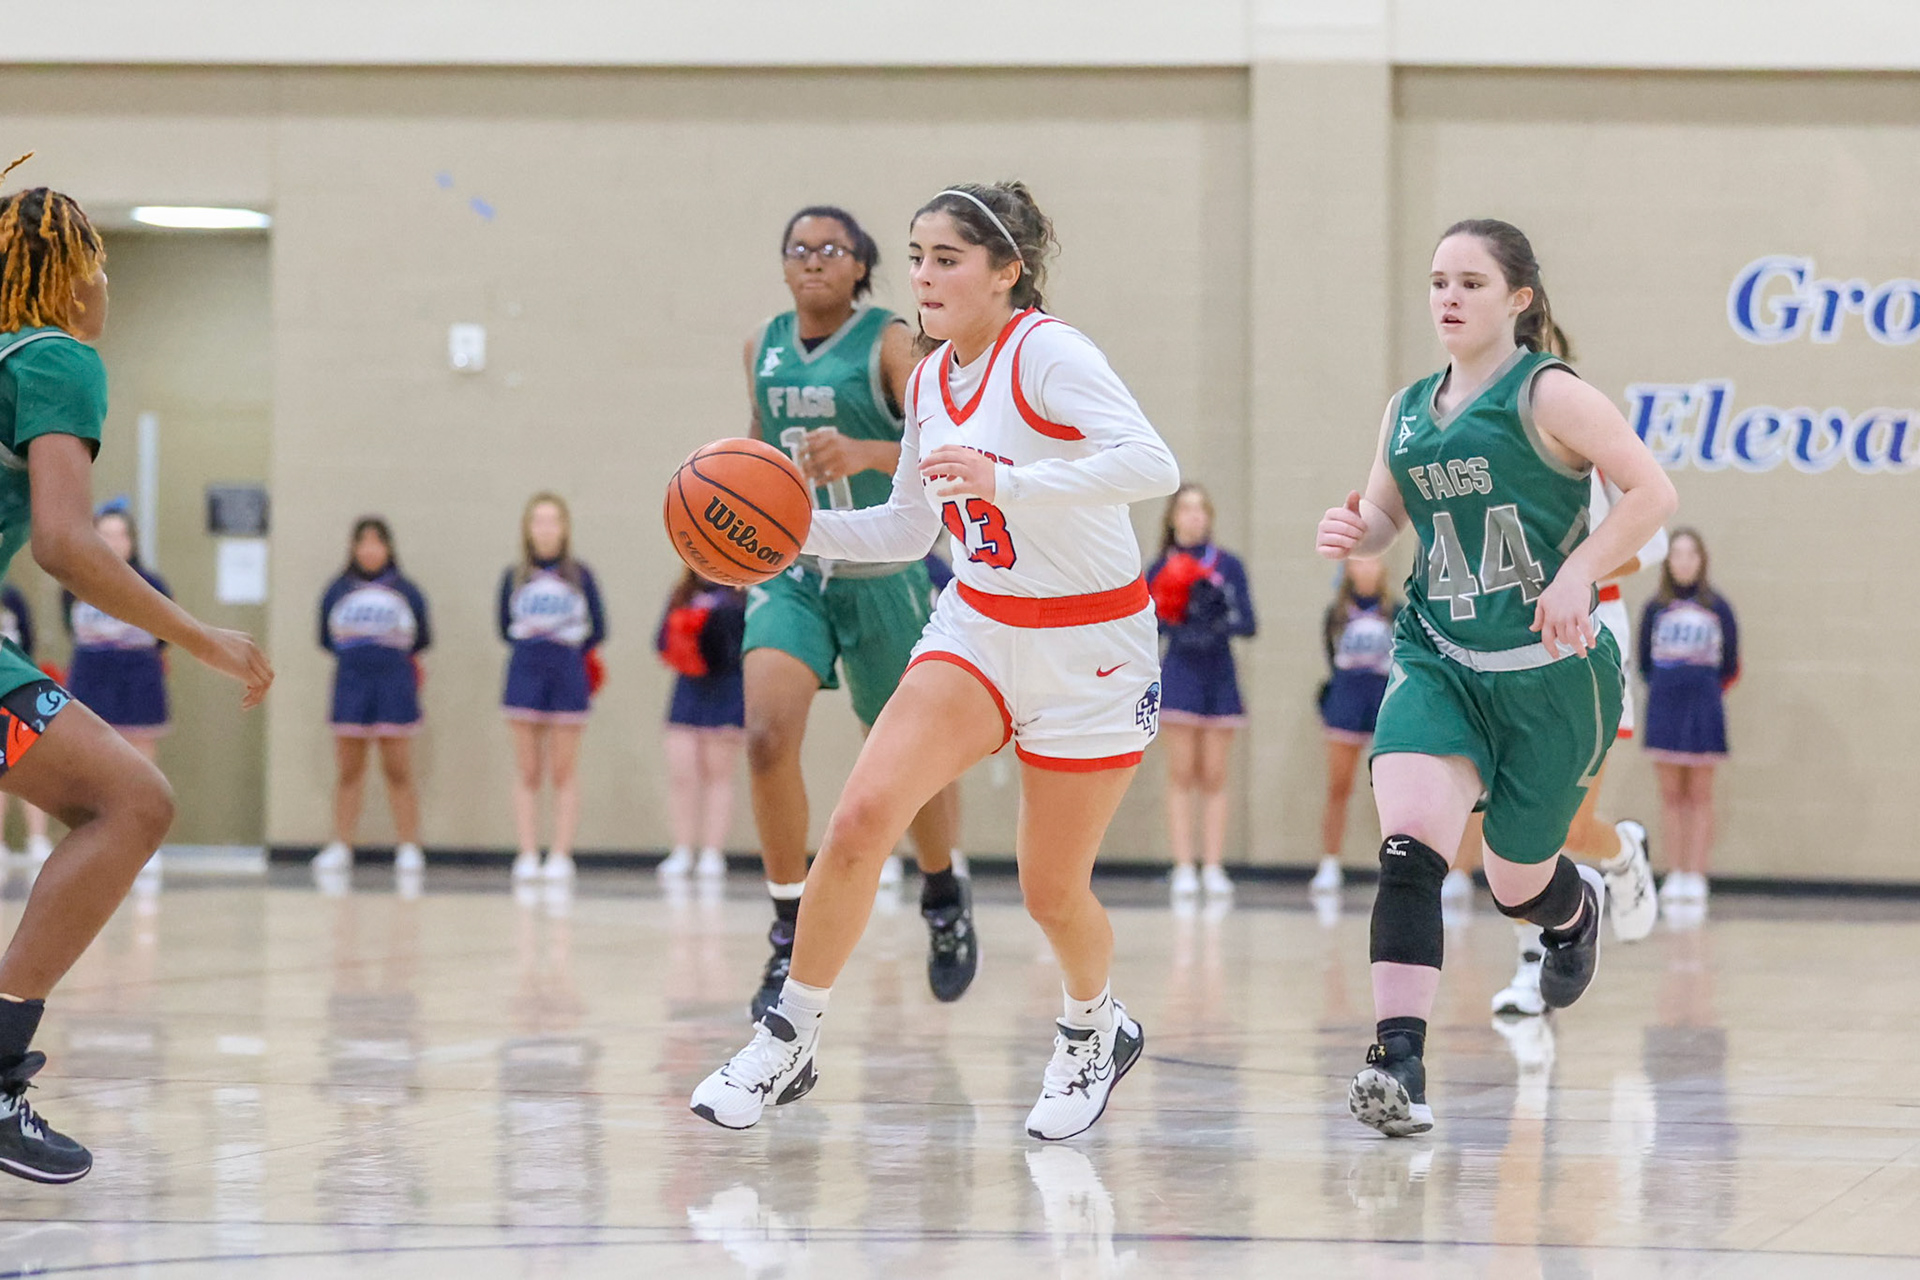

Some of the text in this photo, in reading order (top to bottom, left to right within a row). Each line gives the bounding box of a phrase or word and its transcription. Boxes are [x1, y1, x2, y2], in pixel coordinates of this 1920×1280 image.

[1727, 255, 1920, 344] Gro
[1408, 457, 1493, 500] FACS
[704, 496, 786, 566] Wilson
[941, 498, 1017, 570] 13
[1427, 503, 1545, 621] 44
